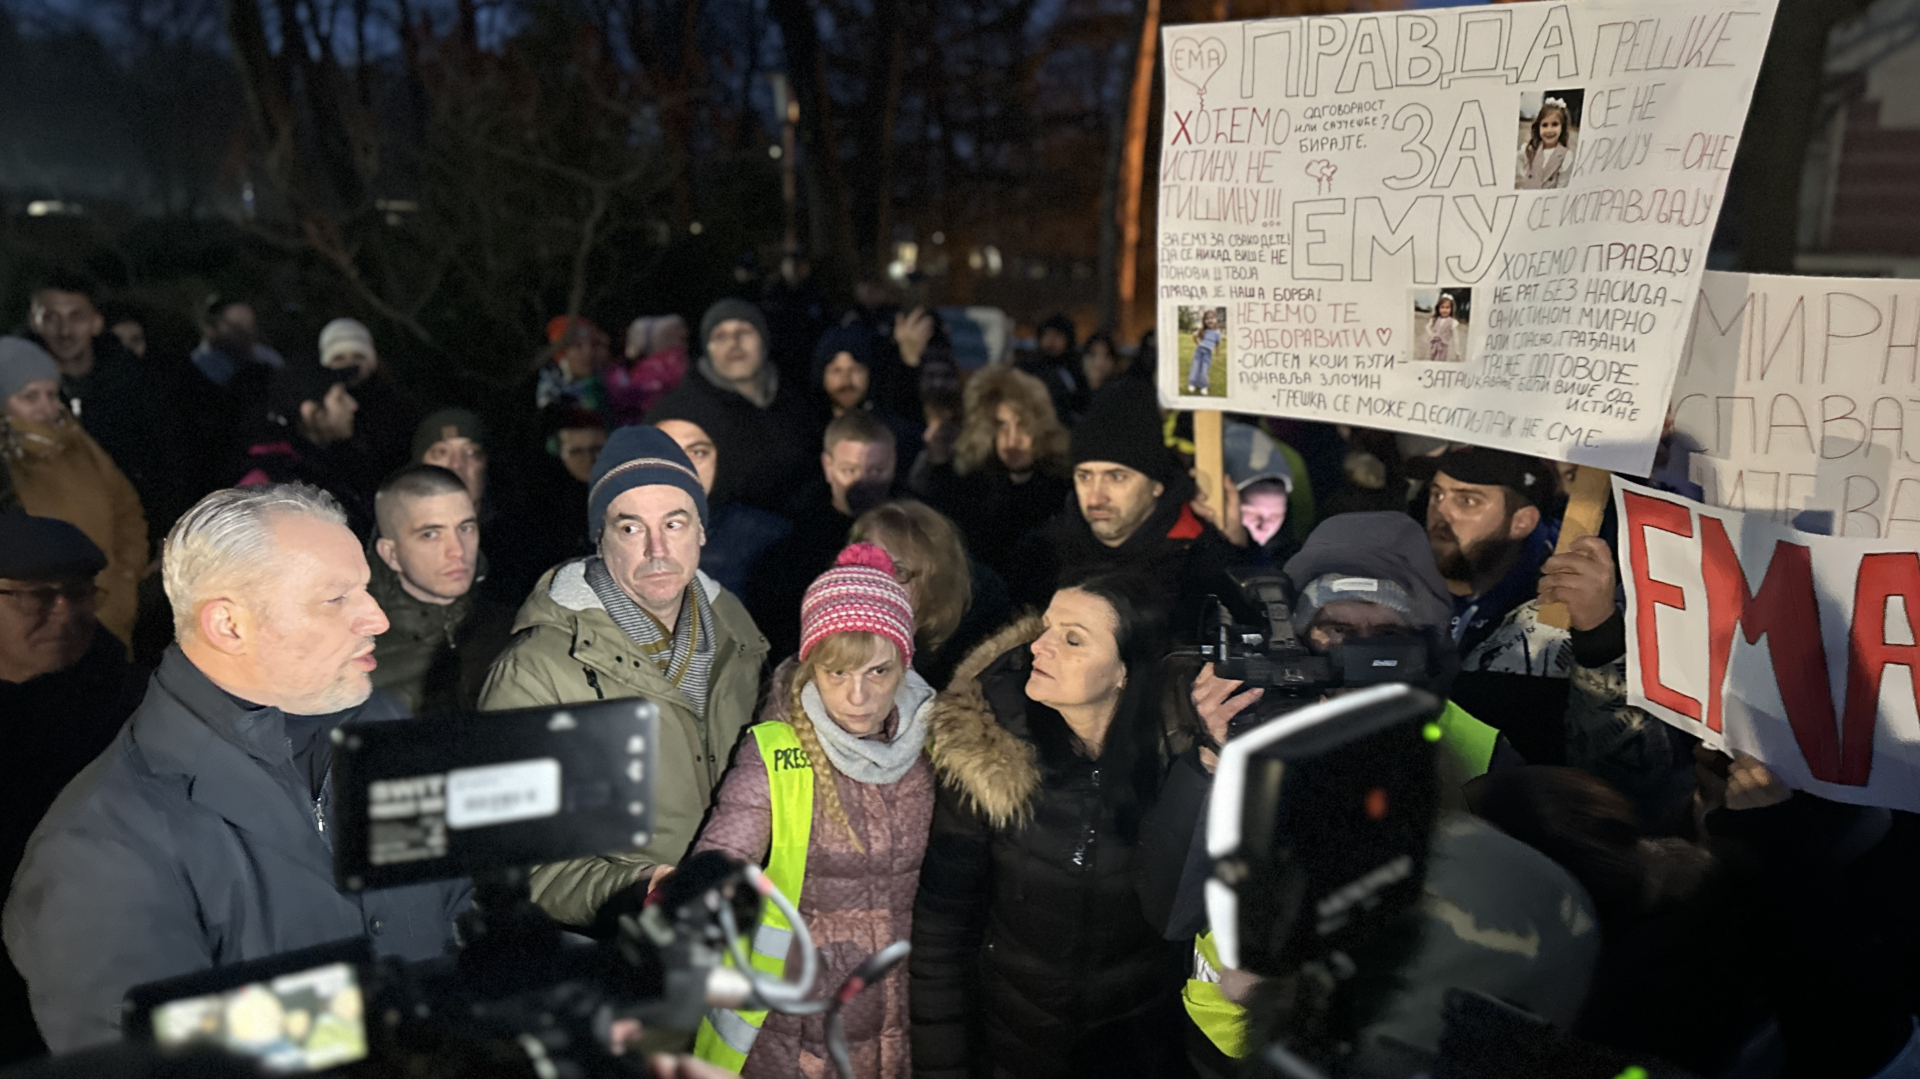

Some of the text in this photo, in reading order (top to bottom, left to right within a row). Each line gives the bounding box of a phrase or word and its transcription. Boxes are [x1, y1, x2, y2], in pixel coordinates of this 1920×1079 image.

[1240, 4, 1579, 99] ПРАВДА
[1589, 11, 1761, 80] ГРЕШКЕ
[1174, 48, 1220, 71] ЕМА
[1303, 99, 1386, 120] ОДГОВОРНОСТ
[1588, 82, 1666, 131] СЕ НЕ
[1171, 107, 1290, 146] ХОЋЕМО
[1294, 123, 1317, 133] ИЛИ
[1299, 133, 1367, 153] БИРАЈТЕ.
[1382, 99, 1497, 191] ЗА
[1572, 131, 1653, 178] КРИЈУ
[1246, 150, 1281, 183] НЕ
[1526, 187, 1714, 231] СЕ ИСПРАВЉАЈУ
[1161, 233, 1179, 247] ЗА
[1210, 233, 1224, 246] ЗА
[1228, 234, 1259, 247] СВАКО
[1261, 233, 1291, 249] ДЕТЕ!
[1292, 194, 1519, 284] ЕМУ
[1160, 249, 1288, 265] ДА СЕ НИКАД ВИШЕ НЕ
[1498, 246, 1577, 281] ХОЋЕМО
[1224, 266, 1259, 280] ТВОЈА
[1160, 285, 1322, 301] ПРАВДА ЈЕ НАША БОРБА!
[1493, 285, 1513, 304] НЕ
[1516, 283, 1540, 302] РАТ
[1542, 277, 1579, 302] БЕЗ
[1237, 302, 1361, 324] НЕЋЕМО ТЕ
[1578, 307, 1656, 335] МИРНО
[1237, 327, 1372, 350] ЗАБОРАВИТИ
[1485, 333, 1509, 350] АЛИ
[1557, 330, 1636, 353] ГРАЂАНИ
[1242, 352, 1300, 369] СИСТЕМ
[1309, 354, 1348, 369] КОЈИ
[1239, 371, 1382, 389] ПОНАВЉА ЗЛОЧИН
[1553, 380, 1602, 398] ВИШЕ
[1277, 388, 1327, 410] ГРЕШКА
[1333, 394, 1351, 412] СЕ
[1356, 396, 1407, 418] МОЖЕ
[1547, 421, 1603, 448] СМЕ.
[1566, 397, 1641, 422] ИСТИНЕ
[1621, 488, 1920, 788] ЕМА
